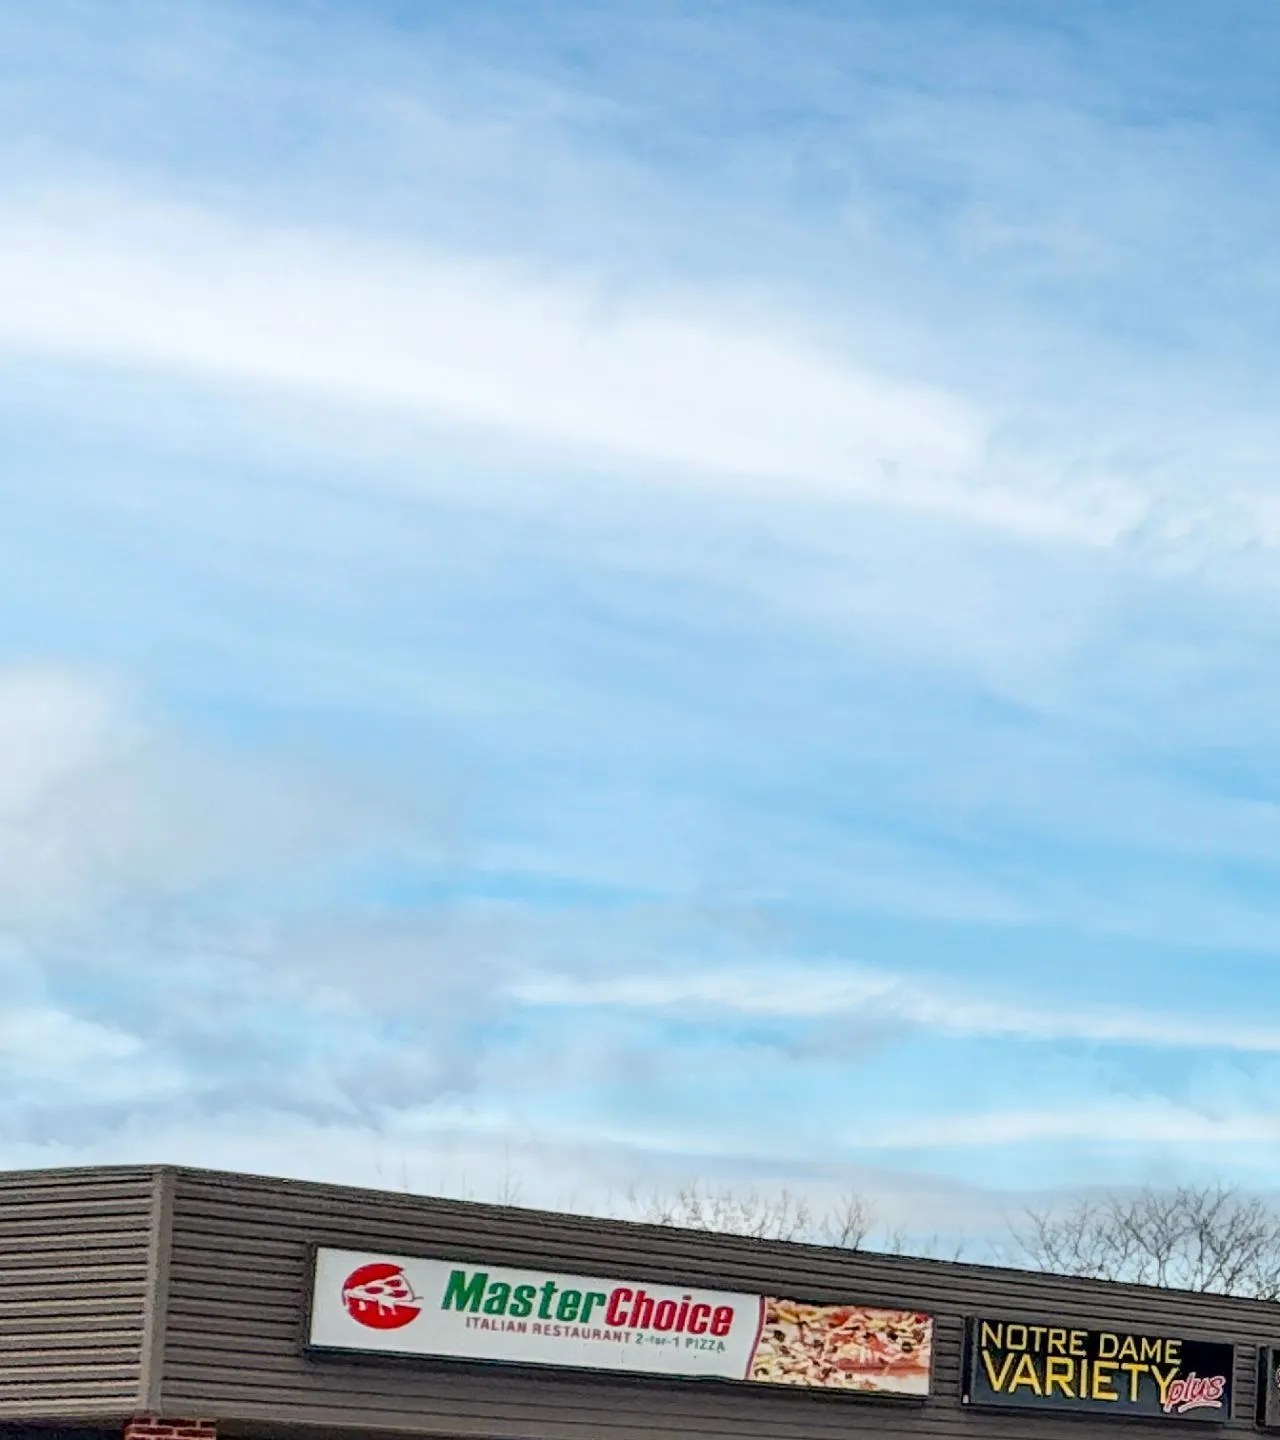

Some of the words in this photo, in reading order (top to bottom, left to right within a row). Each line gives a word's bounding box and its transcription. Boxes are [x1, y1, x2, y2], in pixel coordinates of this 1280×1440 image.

[466, 1316, 527, 1334] ITALIAN
[532, 1322, 632, 1345] RESTAURANT
[685, 1337, 726, 1353] PIZZA
[981, 1321, 1088, 1356] NOTRE
[1099, 1333, 1183, 1365] DAME
[982, 1350, 1180, 1404] VARIETY
[1162, 1371, 1227, 1413] plus
